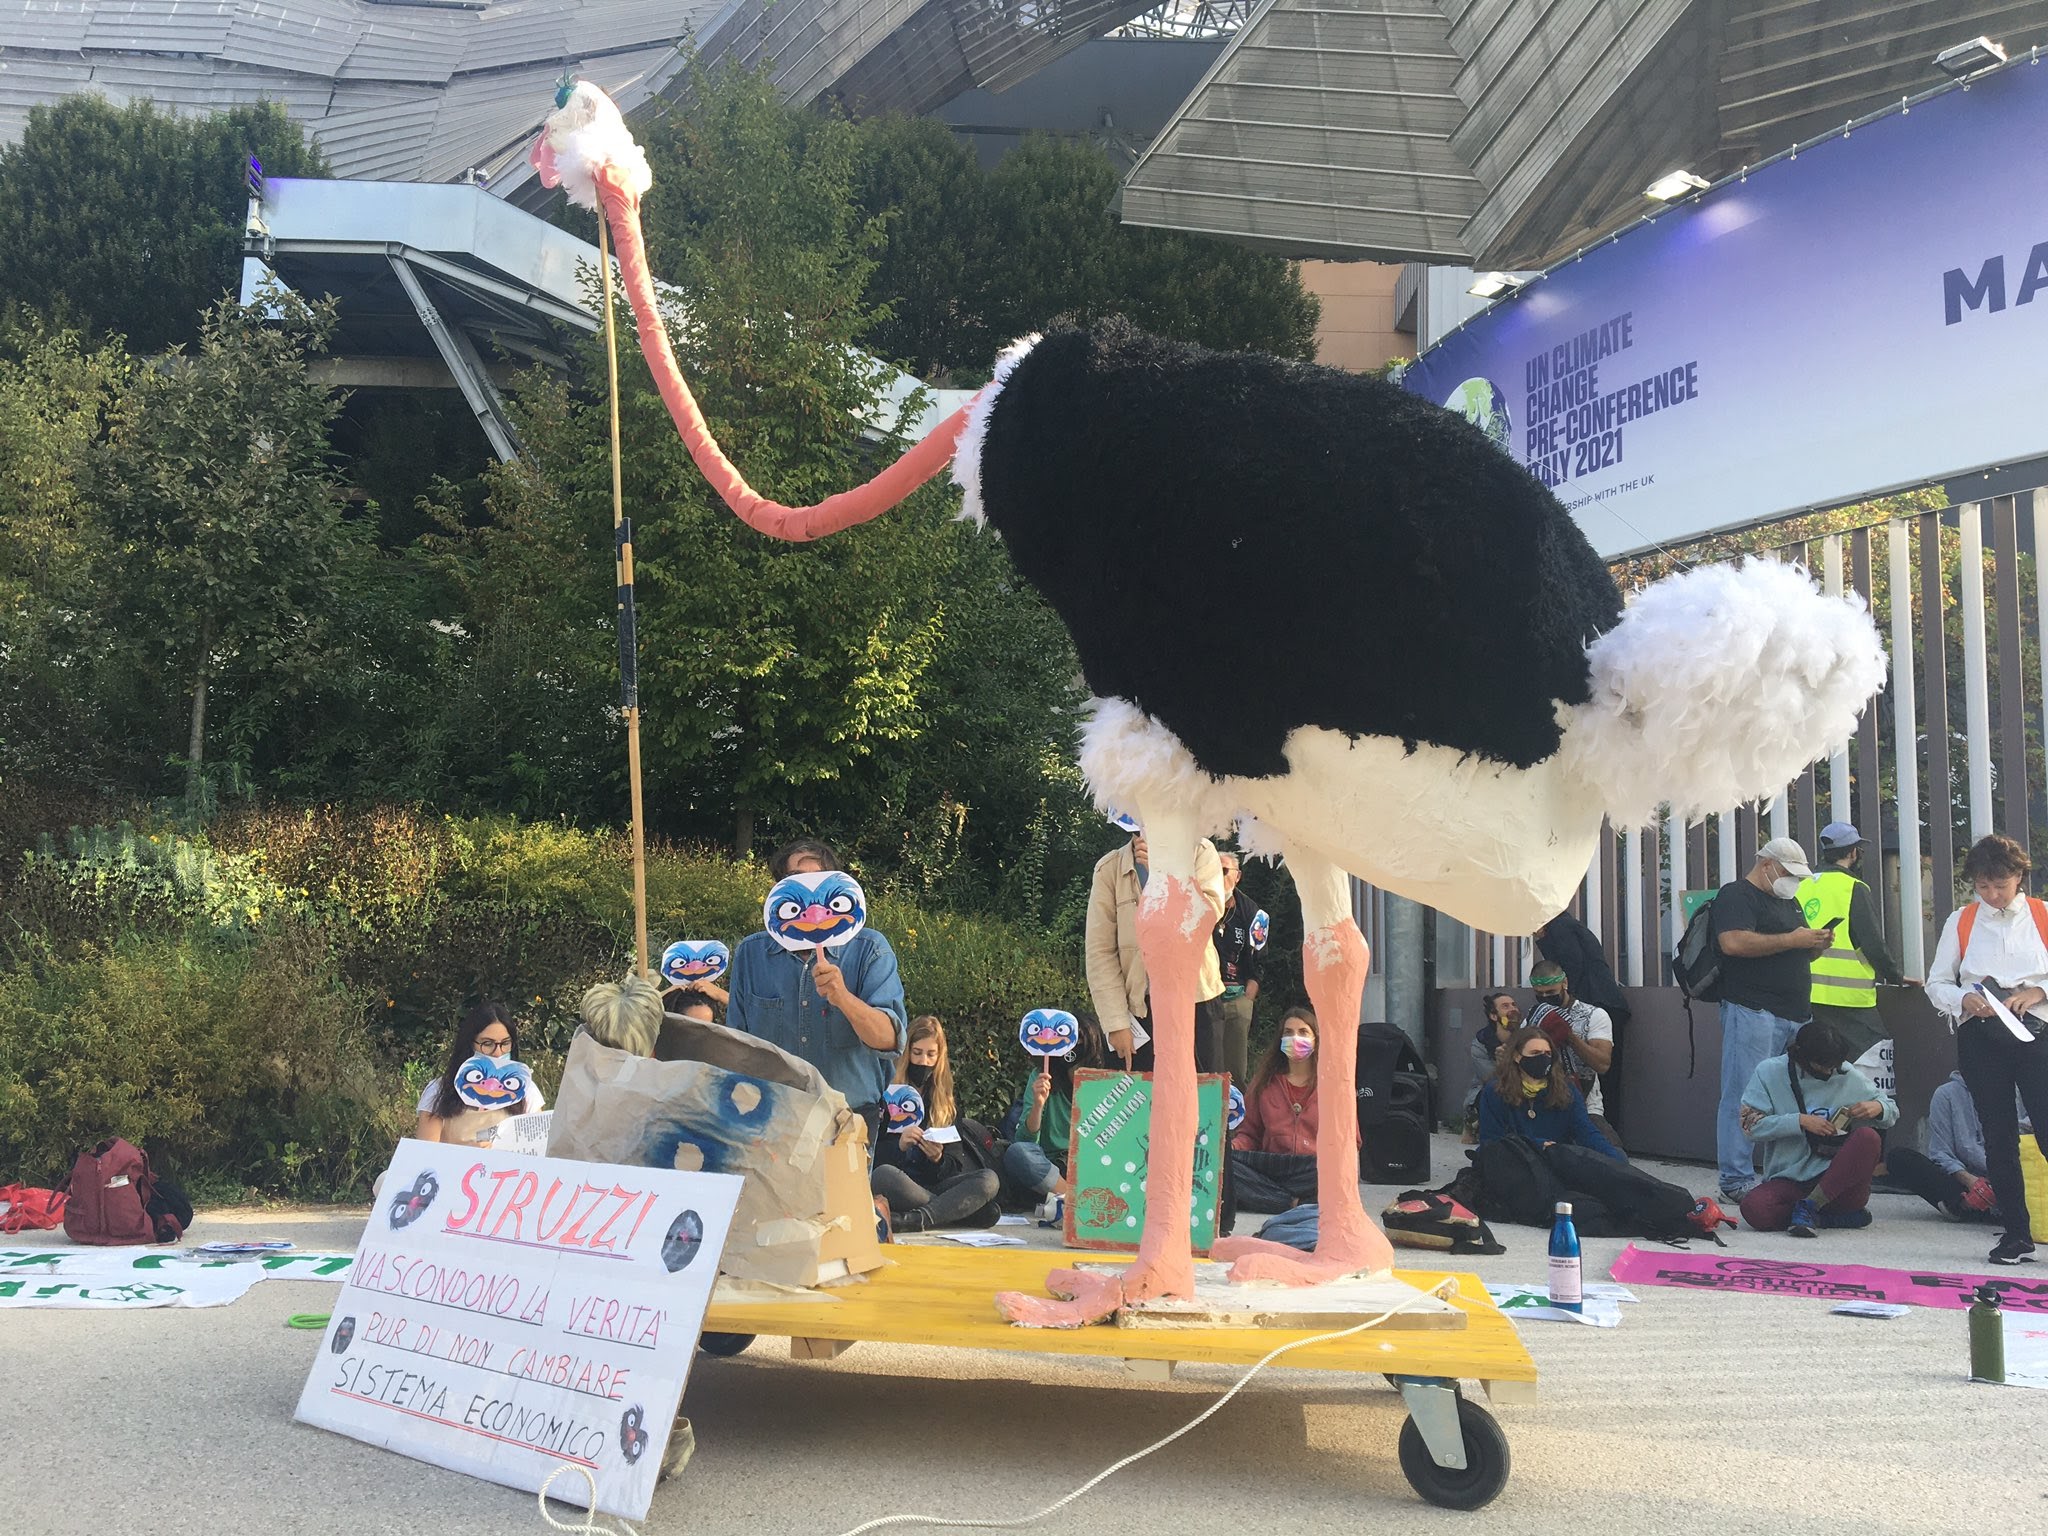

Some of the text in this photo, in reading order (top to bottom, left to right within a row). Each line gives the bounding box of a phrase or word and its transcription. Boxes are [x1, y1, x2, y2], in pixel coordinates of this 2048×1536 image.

[1526, 312, 1633, 394] UN CLIMATE
[1526, 363, 1599, 428] CHANGE
[1526, 360, 1698, 463] PRE-CONFERENCE
[1575, 427, 1623, 478] 2021
[1594, 486, 1617, 502] WITH
[1619, 479, 1639, 494] THE
[1641, 474, 1655, 488] UK
[1076, 1074, 1135, 1138] EXTINCTION
[1094, 1090, 1147, 1149] REBELLION
[446, 1163, 659, 1251] STRUZZI
[351, 1248, 519, 1315] NASCONDONO
[520, 1285, 551, 1324] LA
[364, 1311, 631, 1399] PUR DI NON CAMBIARE
[334, 1357, 605, 1460] SISTEMA ECONOMICO
